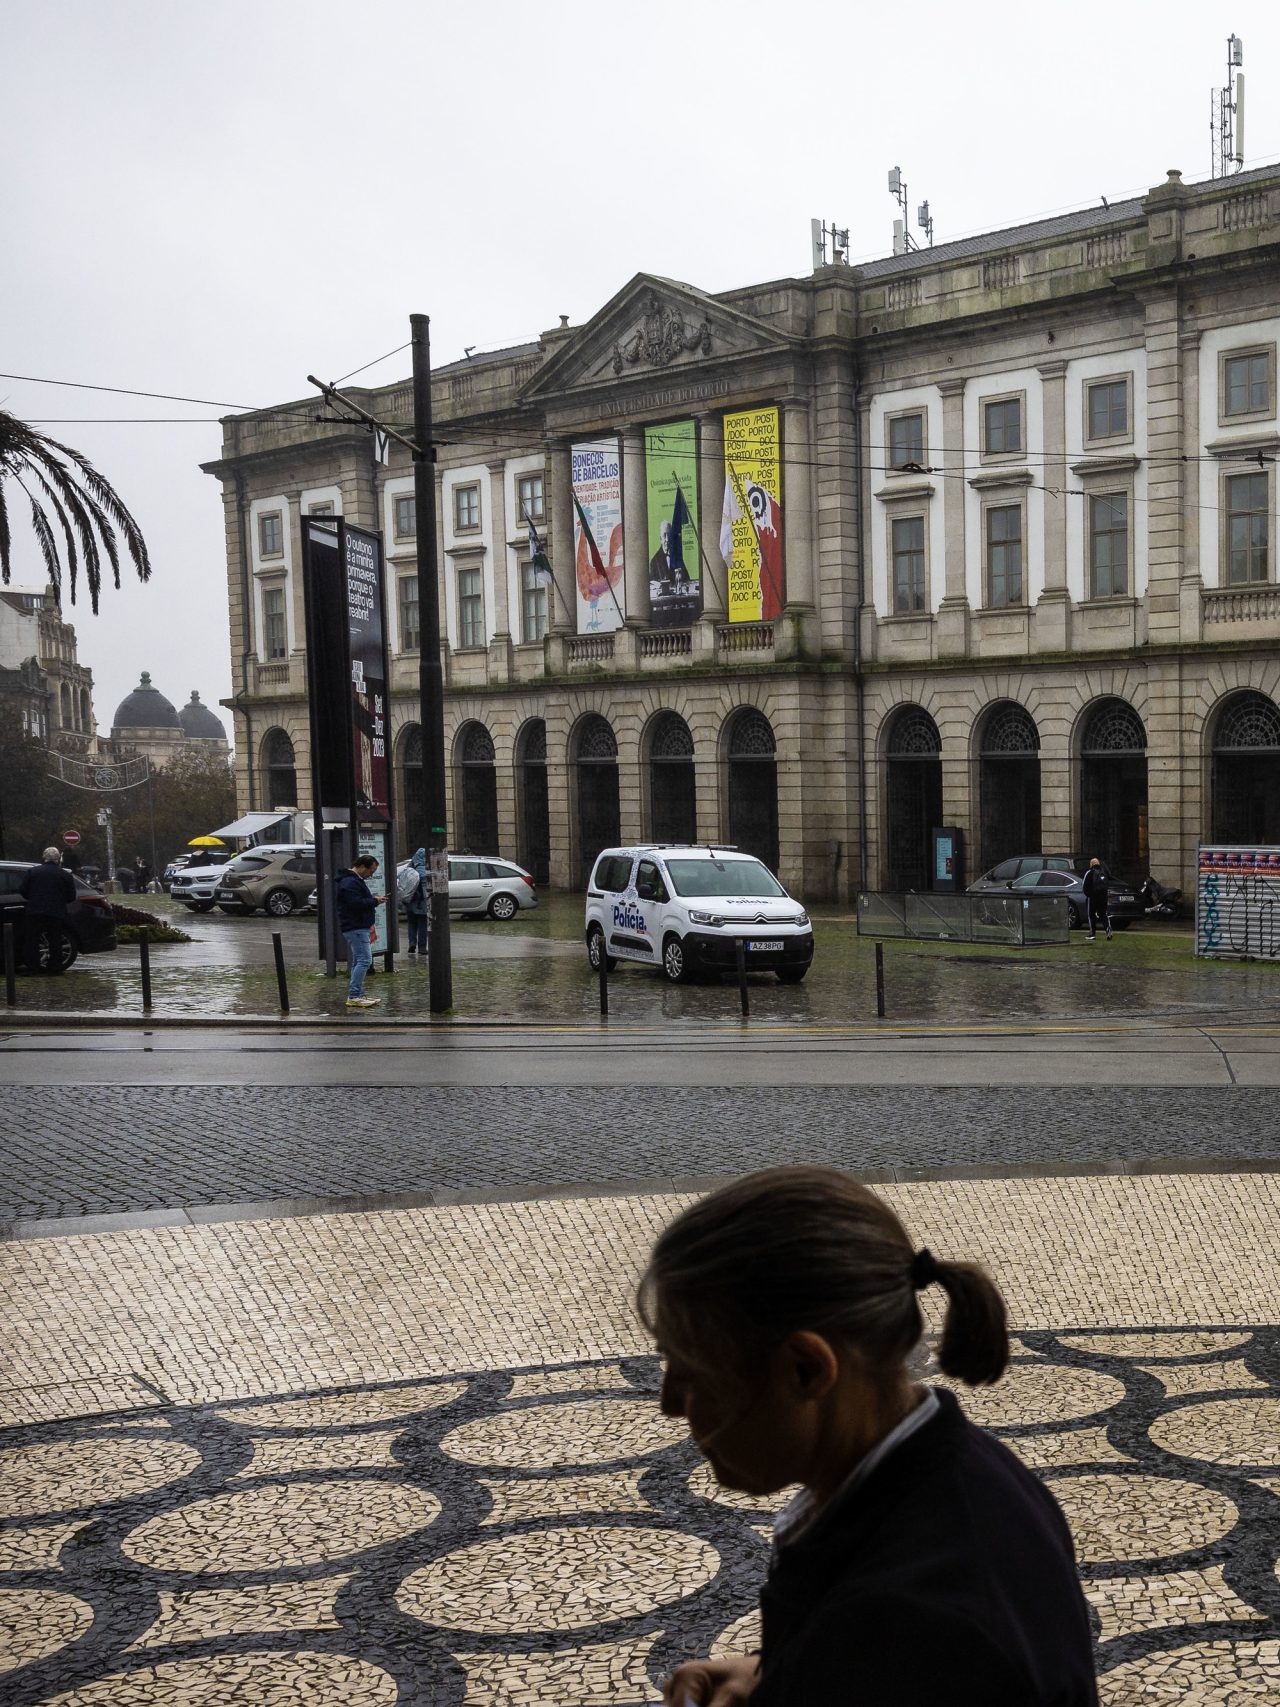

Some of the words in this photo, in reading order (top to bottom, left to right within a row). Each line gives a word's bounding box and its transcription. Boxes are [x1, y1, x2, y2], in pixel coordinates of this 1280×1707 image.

[726, 417, 750, 430] PORTO
[754, 412, 775, 426] /POST
[728, 429, 746, 440] /DOC
[748, 424, 775, 436] PORTO/
[760, 436, 776, 446] DOC
[572, 452, 604, 468] BONECOS
[760, 458, 776, 468] DOC
[572, 470, 582, 482] DE
[582, 463, 618, 480] BARCELOS
[757, 468, 776, 479] POST
[346, 534, 352, 548] O
[352, 539, 373, 556] outono
[352, 552, 355, 563] a
[356, 553, 374, 570] minha
[348, 564, 377, 586] primavera,
[348, 579, 368, 596] porque
[369, 585, 373, 595] o
[730, 581, 754, 591] PORTO
[348, 592, 366, 607] teatro
[366, 596, 374, 609] vai
[731, 592, 749, 602] /DOC
[349, 606, 369, 621] reabrir!
[374, 694, 383, 714] Set
